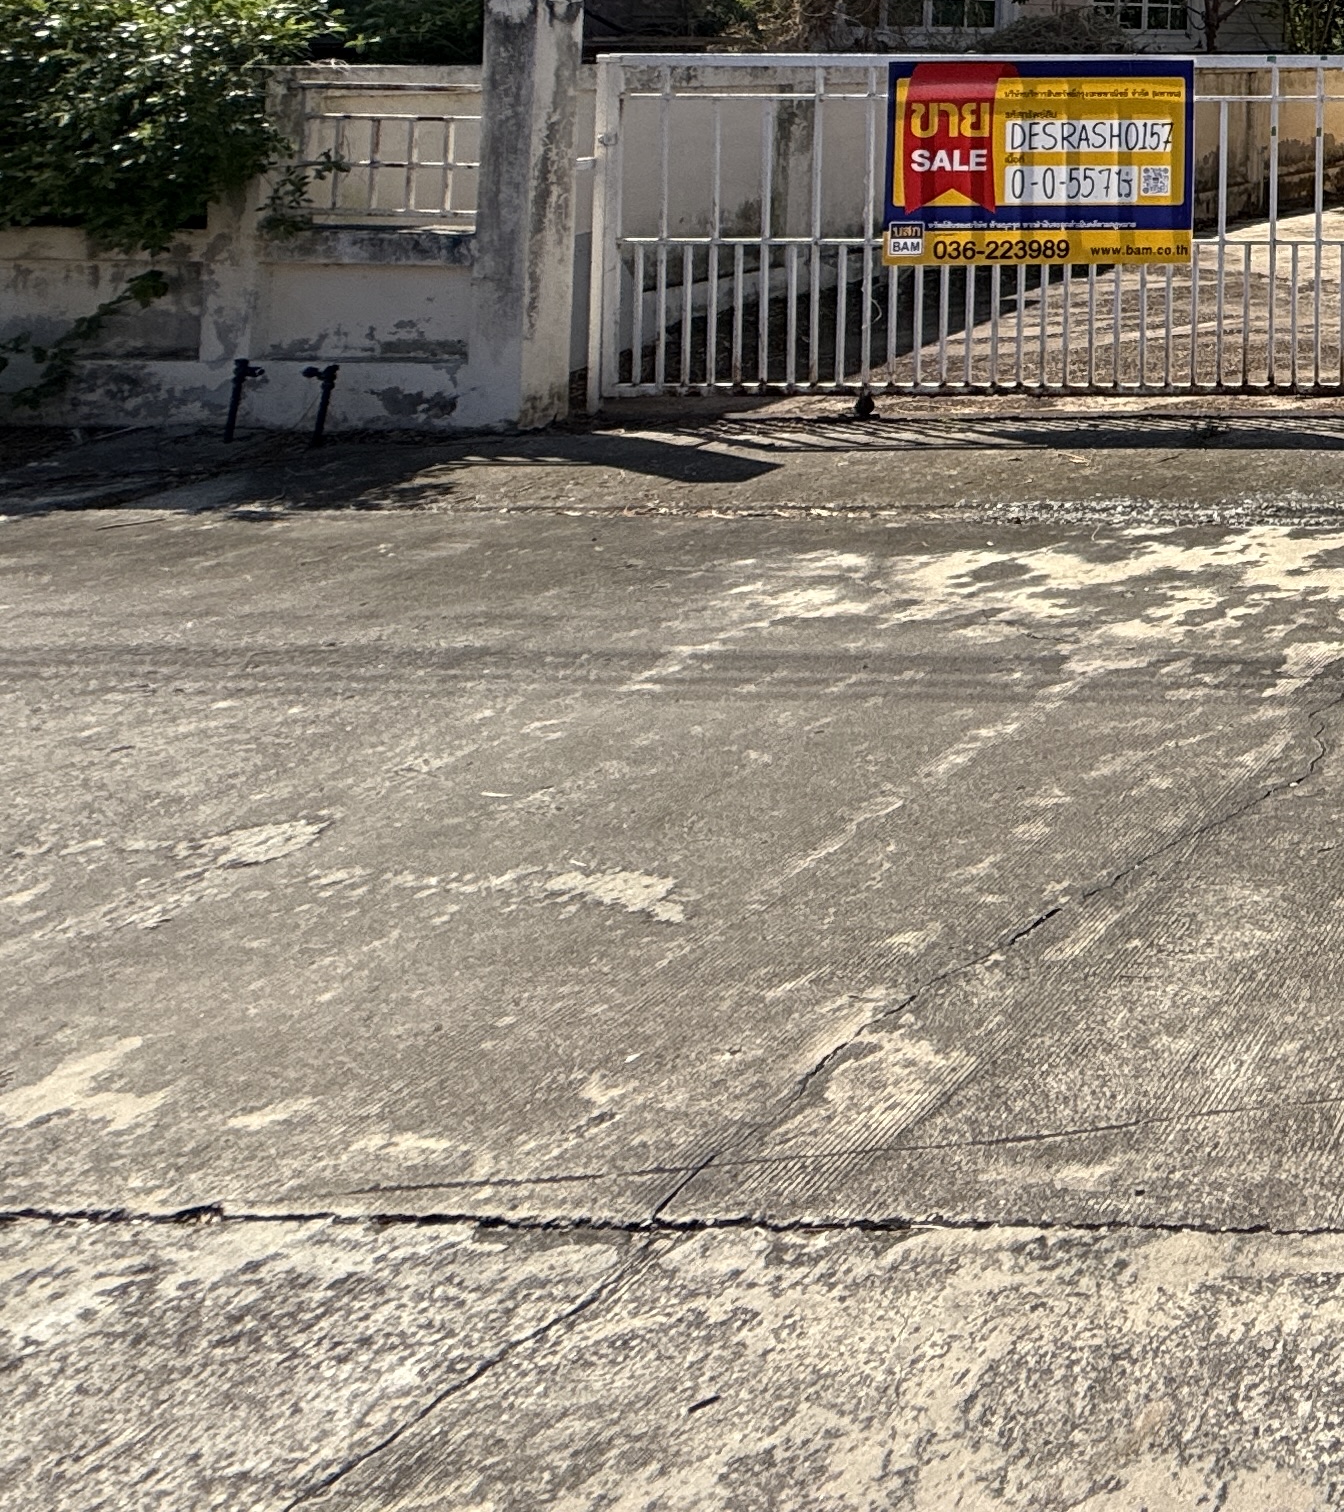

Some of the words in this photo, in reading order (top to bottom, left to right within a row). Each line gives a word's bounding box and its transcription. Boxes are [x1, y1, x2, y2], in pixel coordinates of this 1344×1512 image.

[910, 102, 990, 139] ขาย
[910, 148, 988, 172] SALE
[892, 240, 921, 253] BAM
[933, 239, 1070, 260] 036-223989
[1090, 244, 1189, 257] www.bam.co.th
